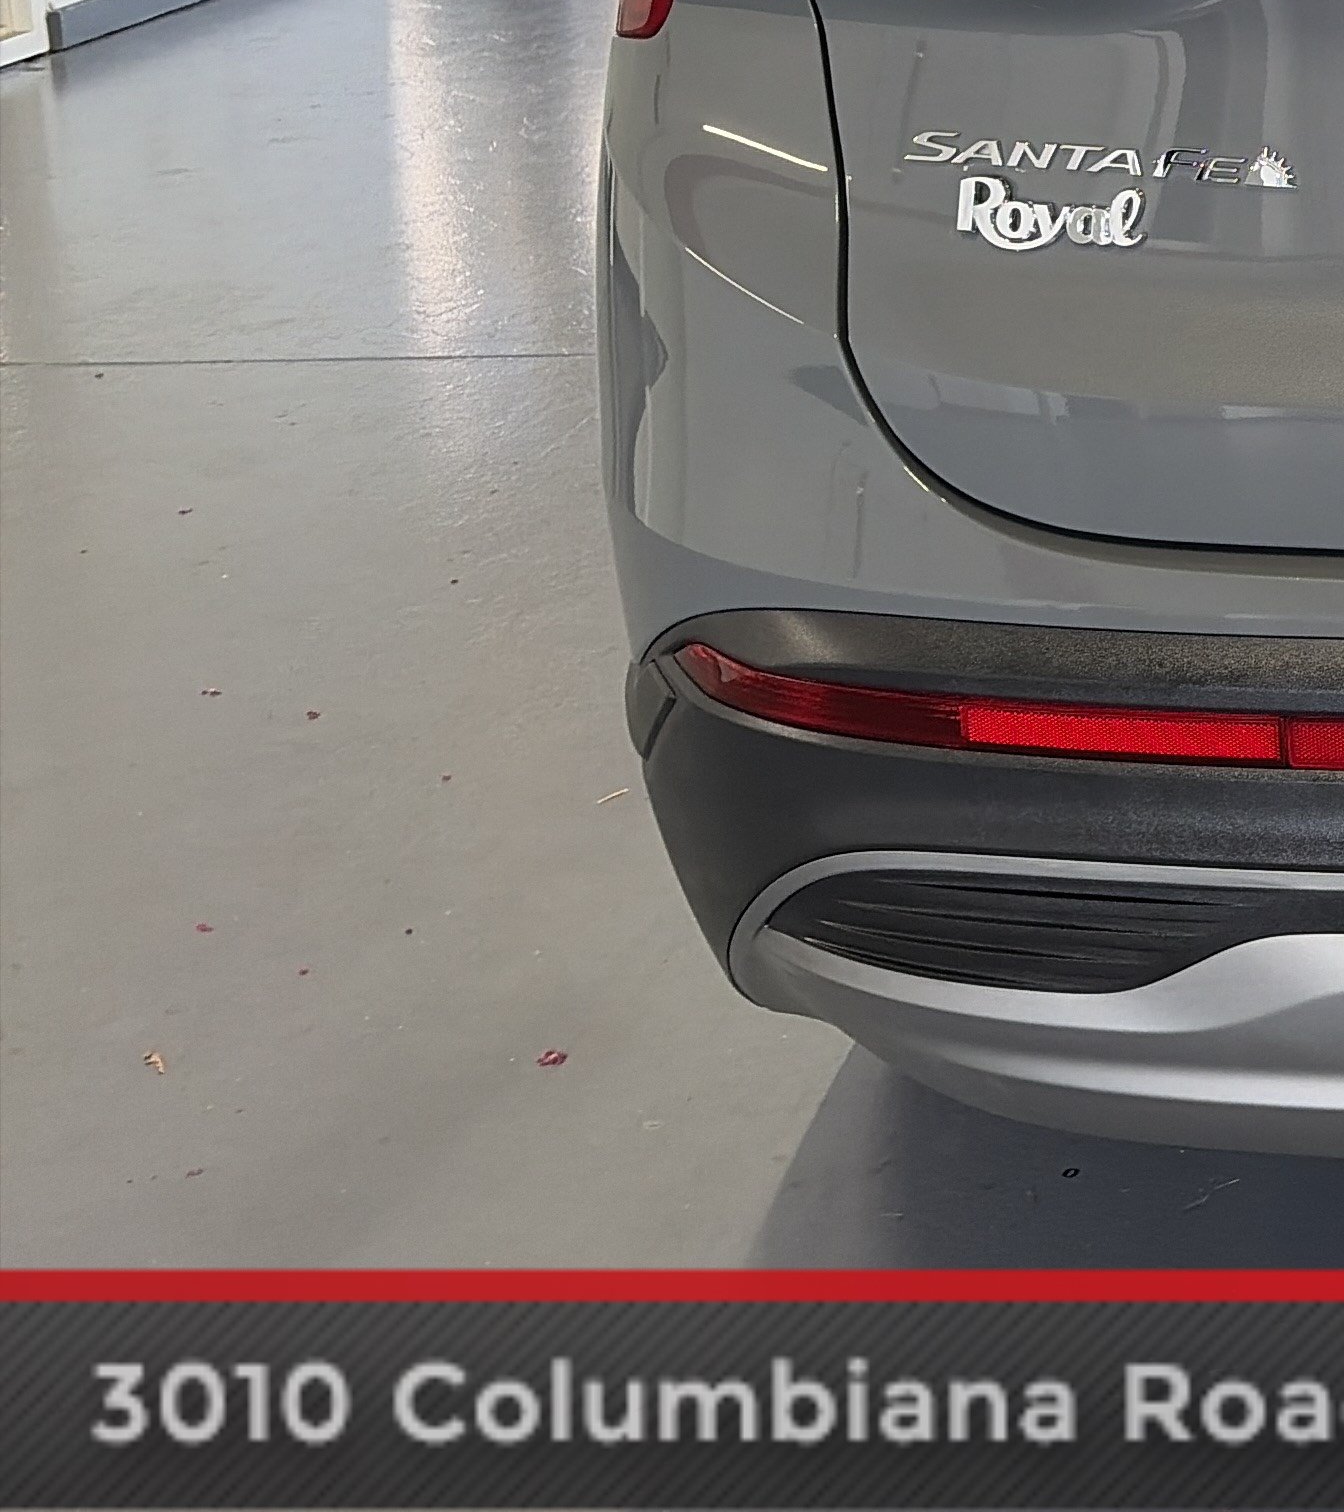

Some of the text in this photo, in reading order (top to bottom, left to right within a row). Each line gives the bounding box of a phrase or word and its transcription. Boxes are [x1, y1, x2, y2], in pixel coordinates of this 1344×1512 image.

[903, 131, 1247, 184] SANTA FE
[956, 175, 1148, 251] Royal
